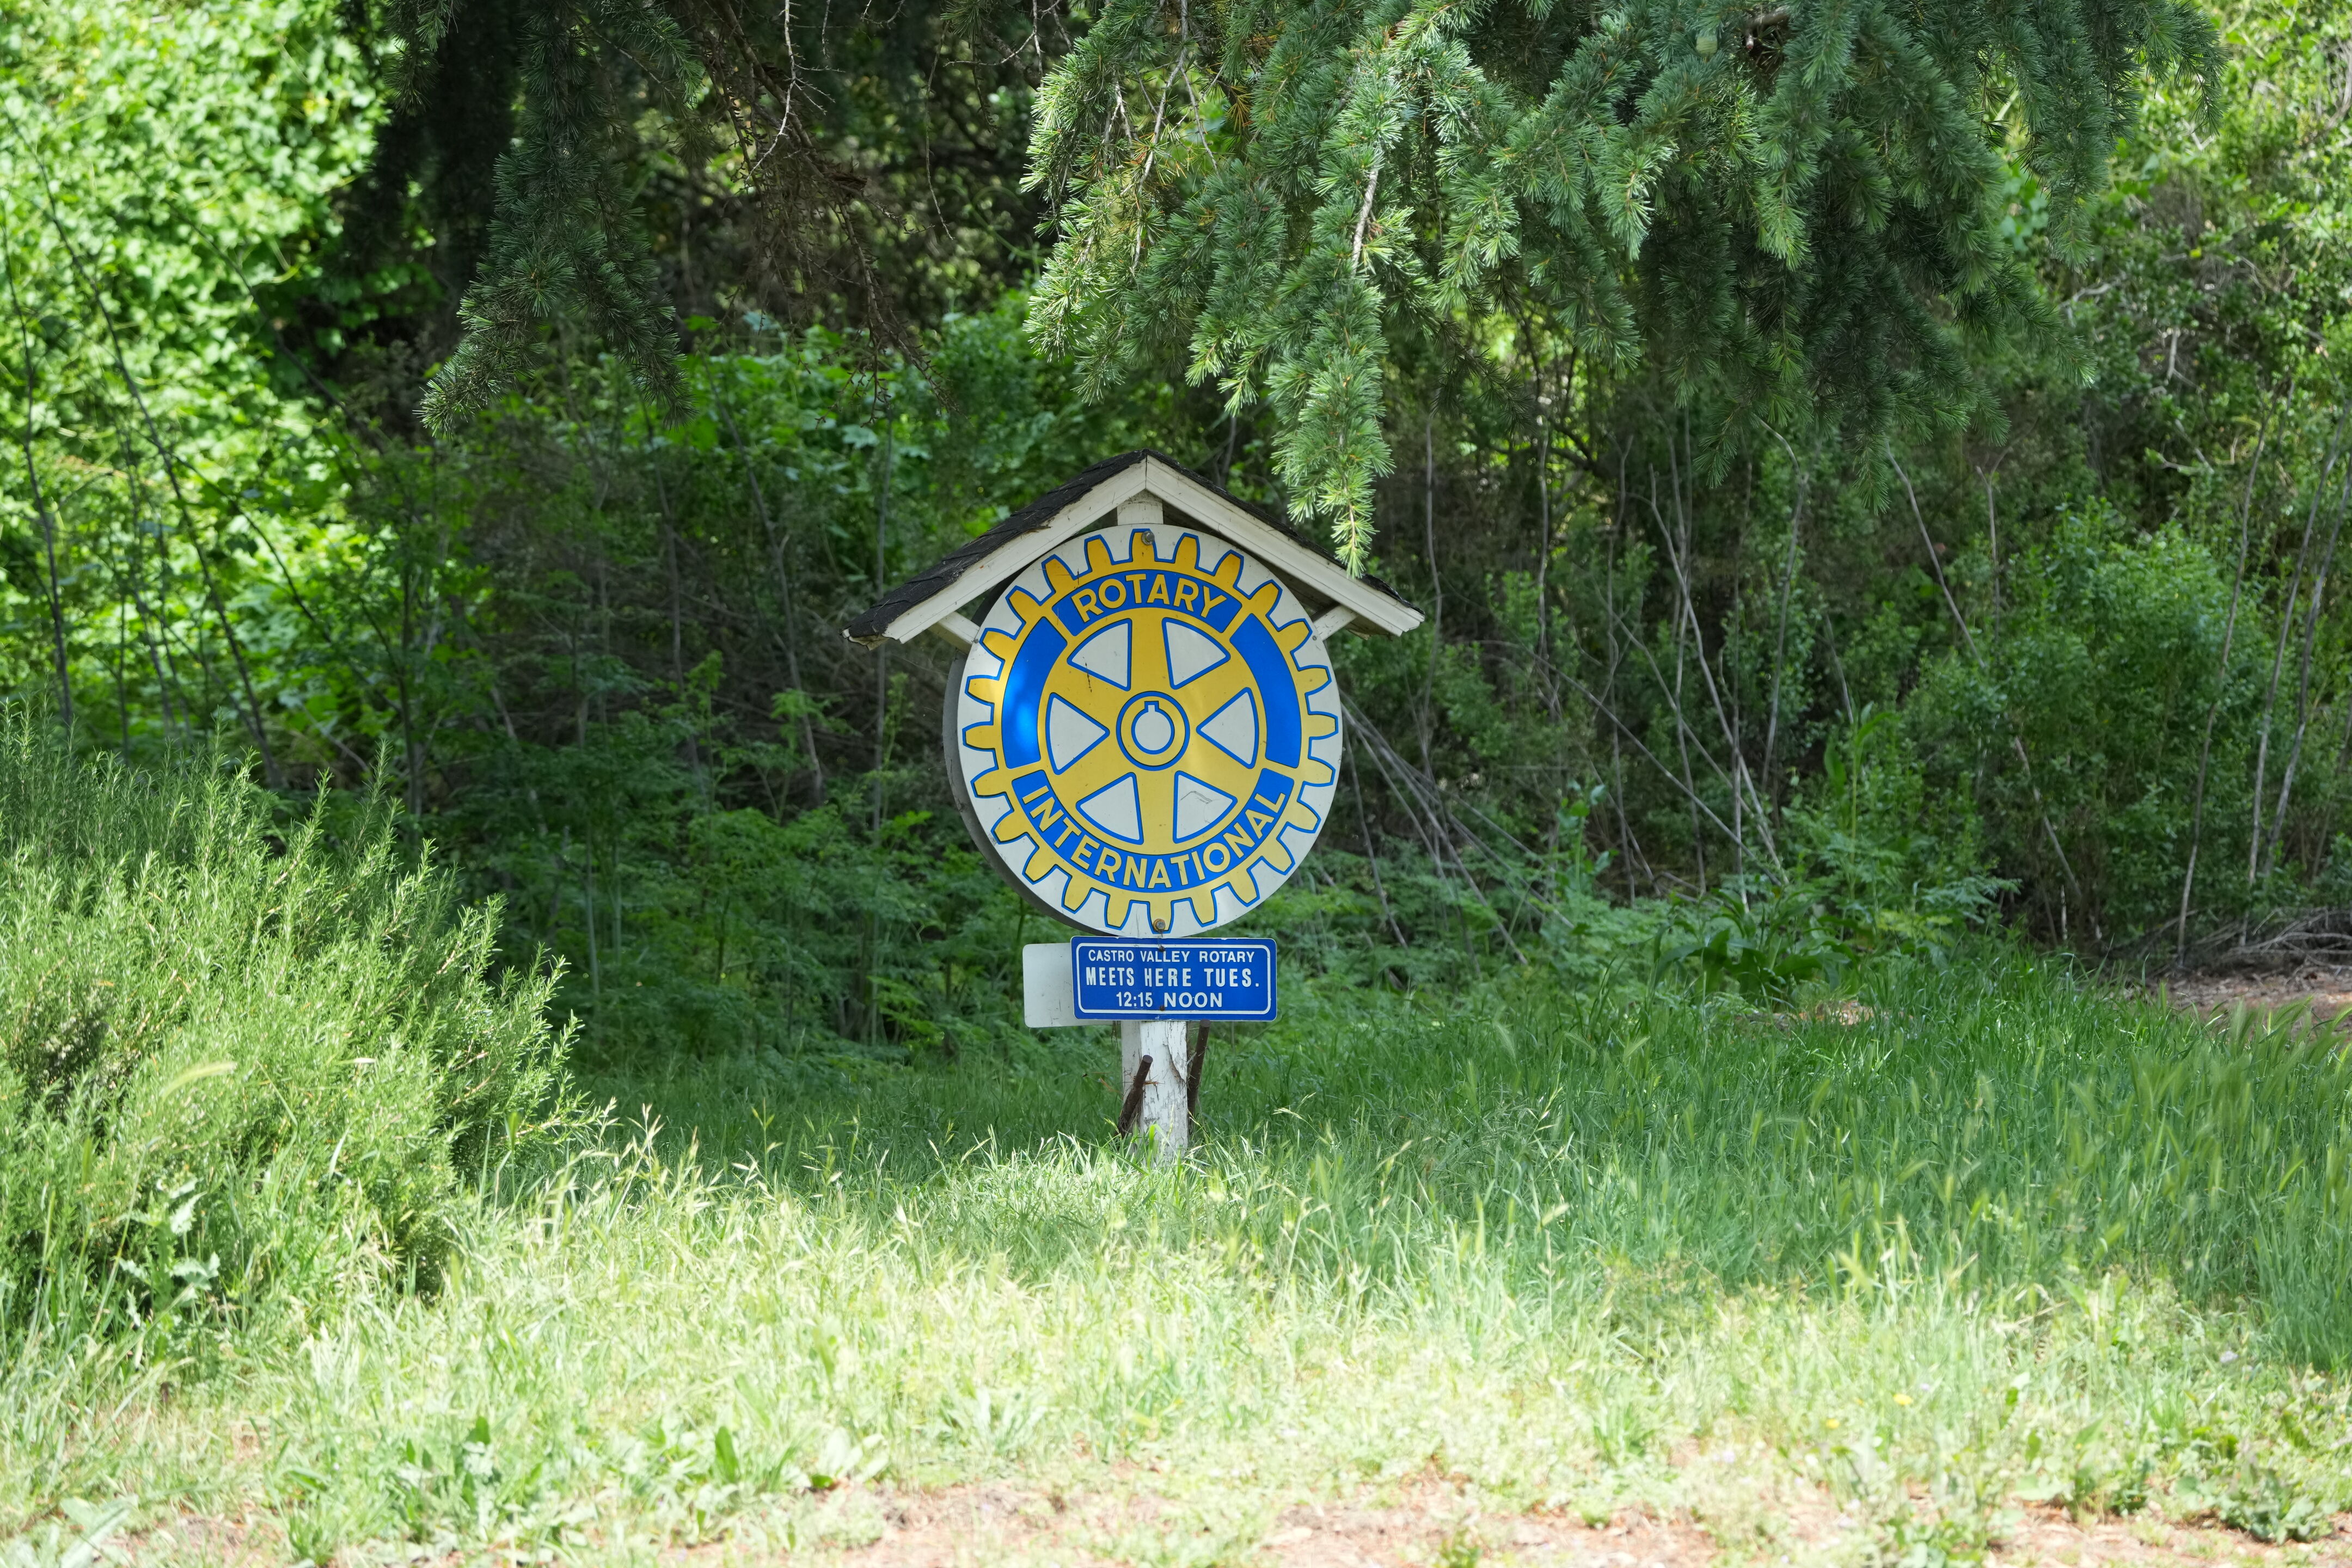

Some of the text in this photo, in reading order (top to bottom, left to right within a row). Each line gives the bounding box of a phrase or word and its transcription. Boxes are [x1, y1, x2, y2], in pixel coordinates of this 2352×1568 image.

[1070, 573, 1228, 622] ROTARY
[1021, 784, 1285, 889] INTERNATIONAL
[1088, 949, 1255, 963] CASTRO VALLEY ROTARY
[1086, 967, 1259, 988] MEETS HERE TUES.
[1116, 992, 1222, 1008] 12:15 NOON
